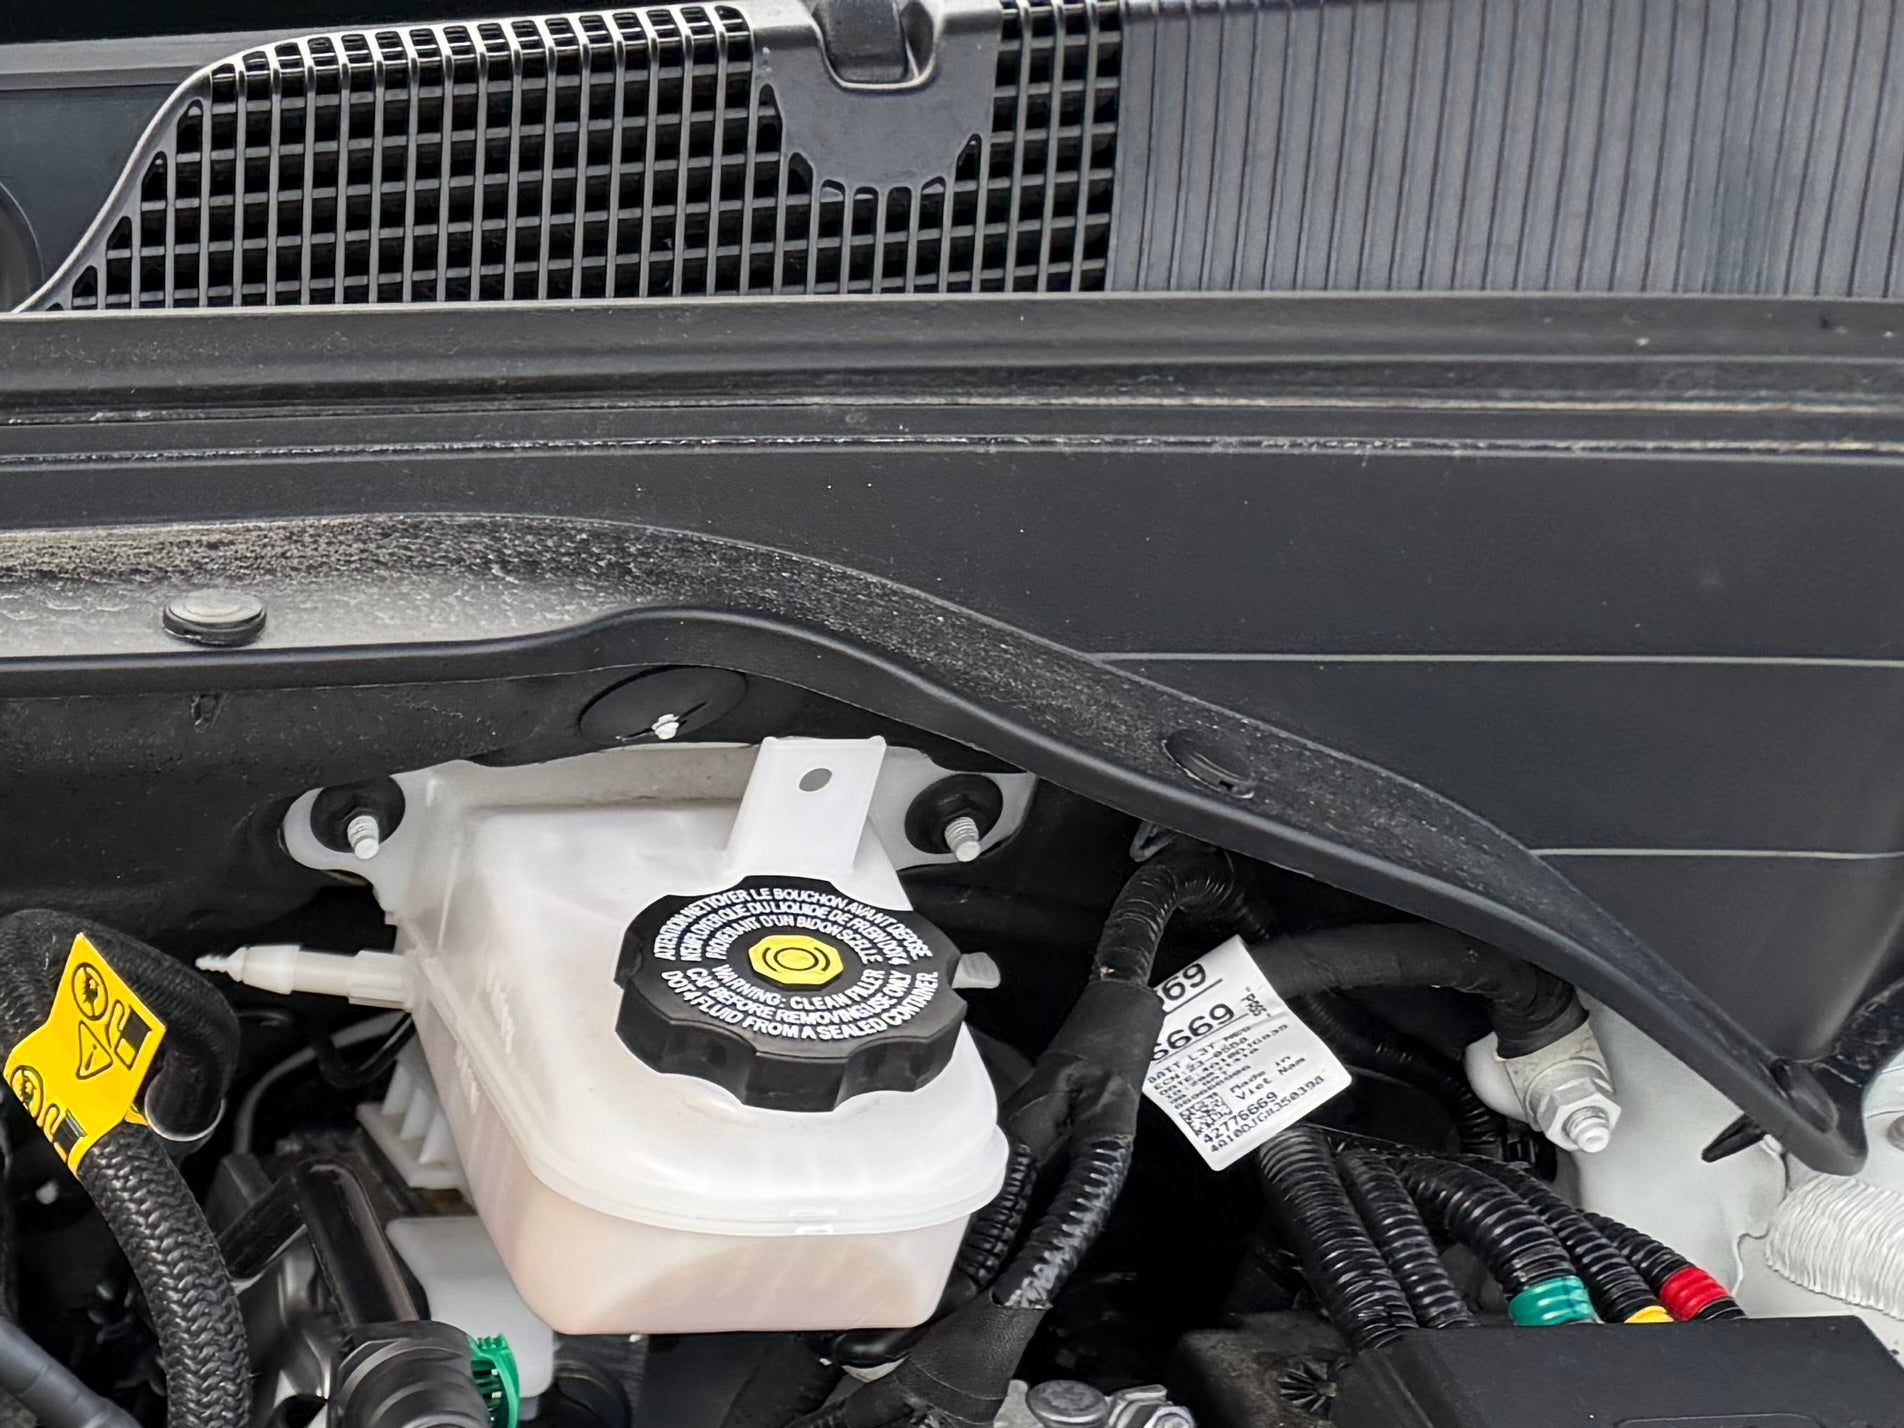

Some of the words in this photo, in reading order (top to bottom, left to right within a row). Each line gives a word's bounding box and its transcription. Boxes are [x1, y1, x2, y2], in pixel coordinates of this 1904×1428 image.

[747, 901, 772, 915] DU
[827, 909, 854, 925] DE
[749, 888, 776, 900] LE
[773, 888, 848, 909] BOUCHON
[845, 901, 898, 928] AVANT
[686, 967, 720, 989] CAP
[707, 986, 778, 1020] BEFORE
[882, 969, 912, 998] ONLY
[711, 963, 787, 1008] WARNING:
[790, 995, 853, 1010] CLEAN
[844, 968, 886, 1002] FILLER
[1161, 962, 1207, 1002] 69
[689, 995, 745, 1024] FLUID
[741, 1015, 801, 1039] FROM
[800, 1025, 818, 1040] A
[816, 1016, 889, 1041] SEALED
[1203, 1090, 1279, 1145] 42776669
